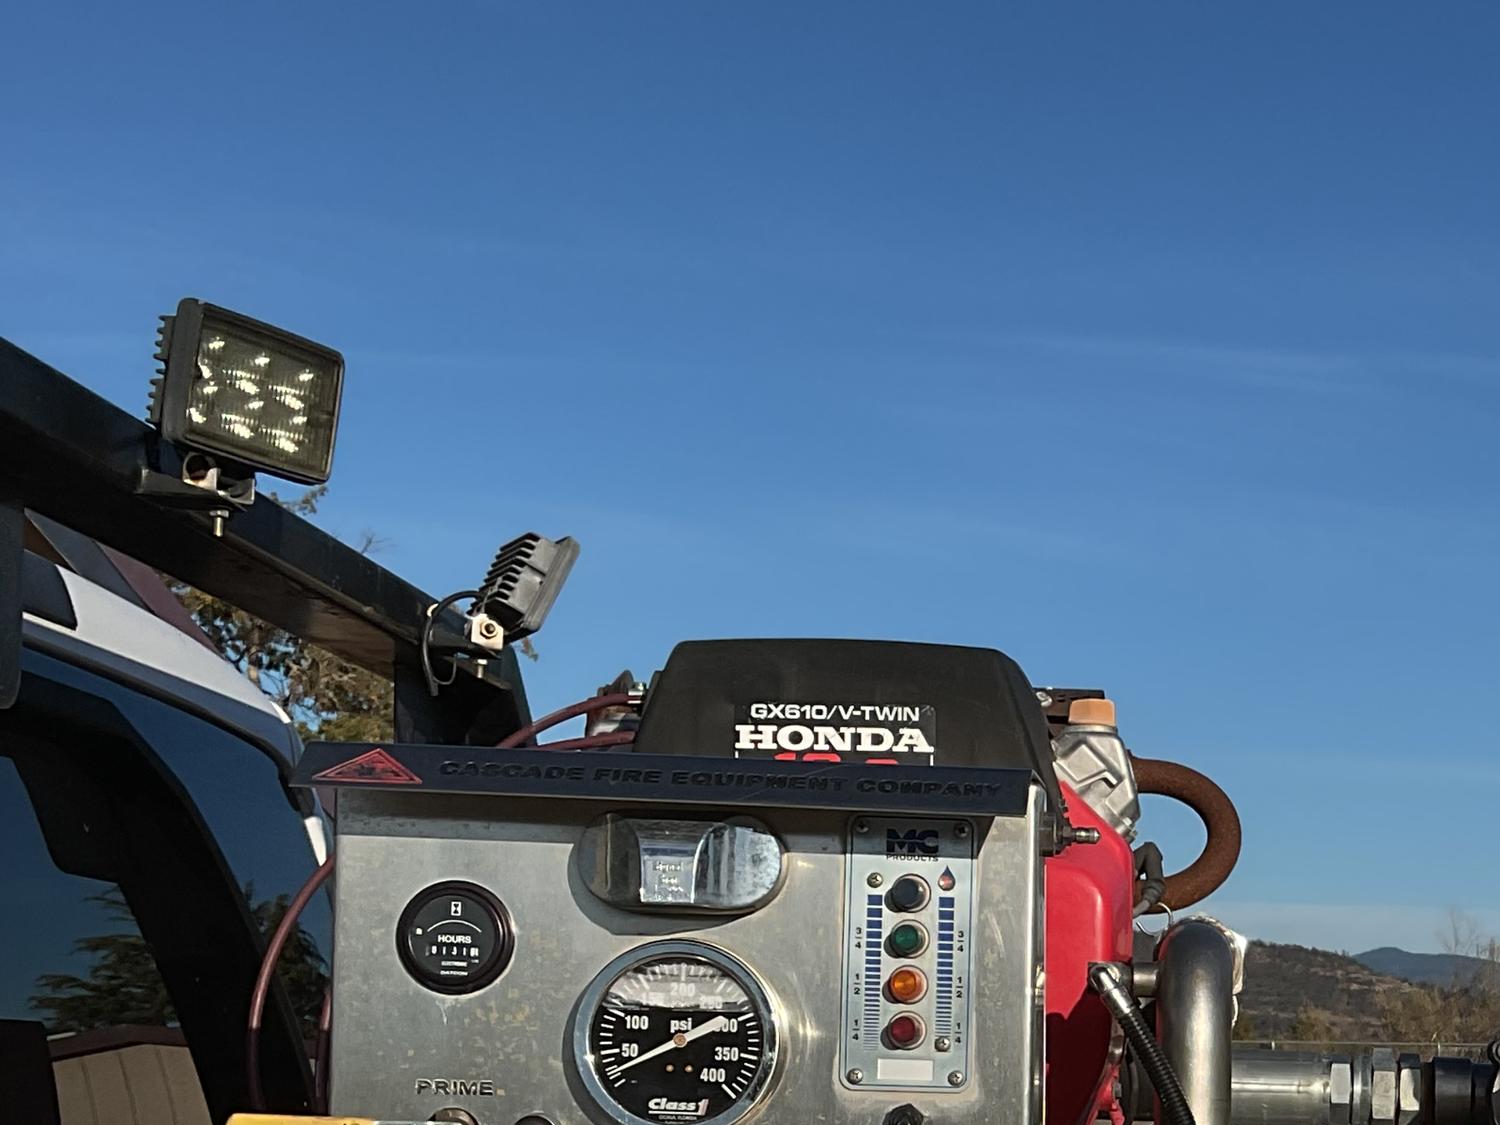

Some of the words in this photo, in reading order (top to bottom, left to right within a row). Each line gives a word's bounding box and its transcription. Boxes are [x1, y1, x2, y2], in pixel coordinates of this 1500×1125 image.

[750, 704, 920, 721] GX610/V-TWIN
[735, 725, 934, 752] HONDA
[439, 760, 585, 781] CASCADE
[593, 766, 664, 784] FIRE
[671, 769, 847, 792] EQUIPMENT
[856, 778, 1001, 799] COMPANY
[886, 829, 939, 854] MC
[886, 854, 939, 862] PRODUCTS
[437, 935, 472, 944] HOURS
[670, 982, 696, 997] 200
[625, 1015, 649, 1030] 100
[670, 1017, 692, 1034] psi
[712, 1018, 738, 1033] 00
[621, 1043, 639, 1058] 50
[714, 1047, 739, 1061] 350
[700, 1068, 726, 1082] 400
[416, 1080, 493, 1096] PRIME
